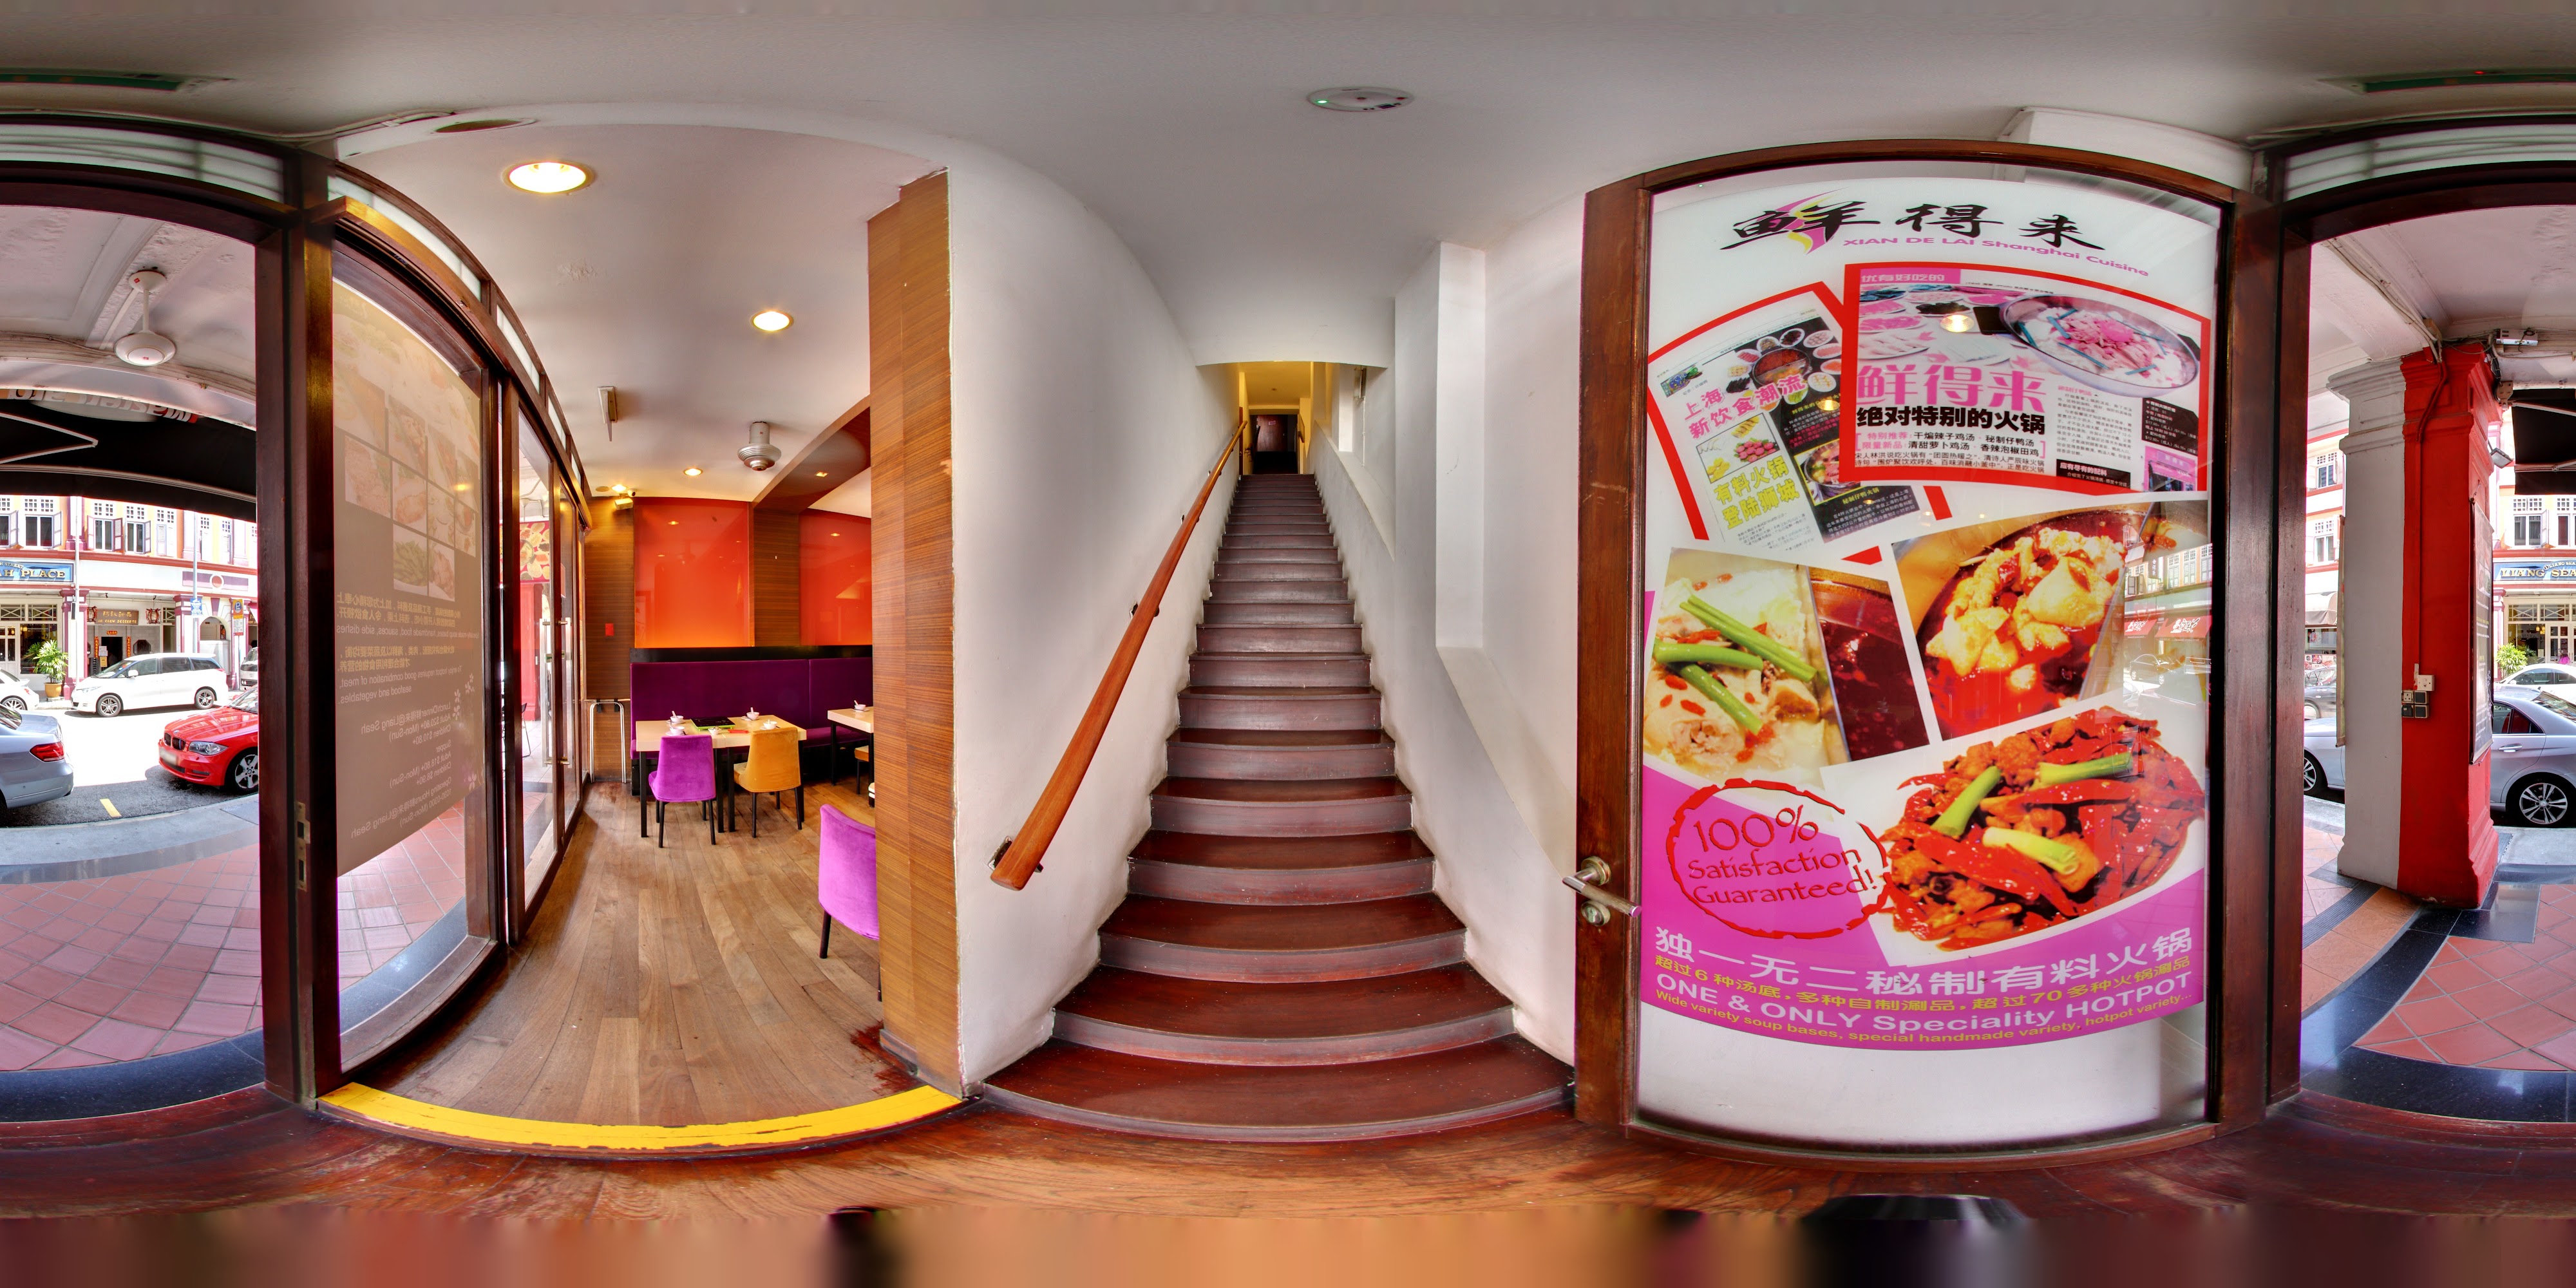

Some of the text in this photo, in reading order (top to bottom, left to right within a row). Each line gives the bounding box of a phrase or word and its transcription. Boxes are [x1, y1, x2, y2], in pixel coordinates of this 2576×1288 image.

[1720, 201, 2105, 251] 鲜得来
[1843, 238, 1898, 247] XIAN
[1982, 241, 2079, 260] Shanghai
[2086, 256, 2149, 276] Cuisine
[1685, 388, 1724, 421] 上海
[1689, 374, 1806, 439] 新饮食潮流
[1856, 364, 2046, 413] 鲜得来
[1856, 406, 2045, 435] 绝对特别的火锅
[1908, 441, 1970, 450] 清甜萝卜鸡汤
[1980, 443, 2040, 457] 香辣泡椒田鸡
[1714, 455, 1789, 505] 有料火锅
[1722, 478, 1800, 530] 登陆狮城
[21, 569, 65, 578] PLACE
[2501, 569, 2544, 578] LIANG
[1693, 804, 1819, 852] 100%
[1689, 848, 1861, 878] Satisfaction
[1693, 865, 1877, 904] Guaranteed!
[1656, 926, 2192, 996] 独一无二秘制有料火锅
[1656, 989, 2192, 1043] Wide variety soup bases, special handmade variety, hotpot variety...
[1657, 971, 2192, 1034] ONE & ONLY Speciality HOTPOT
